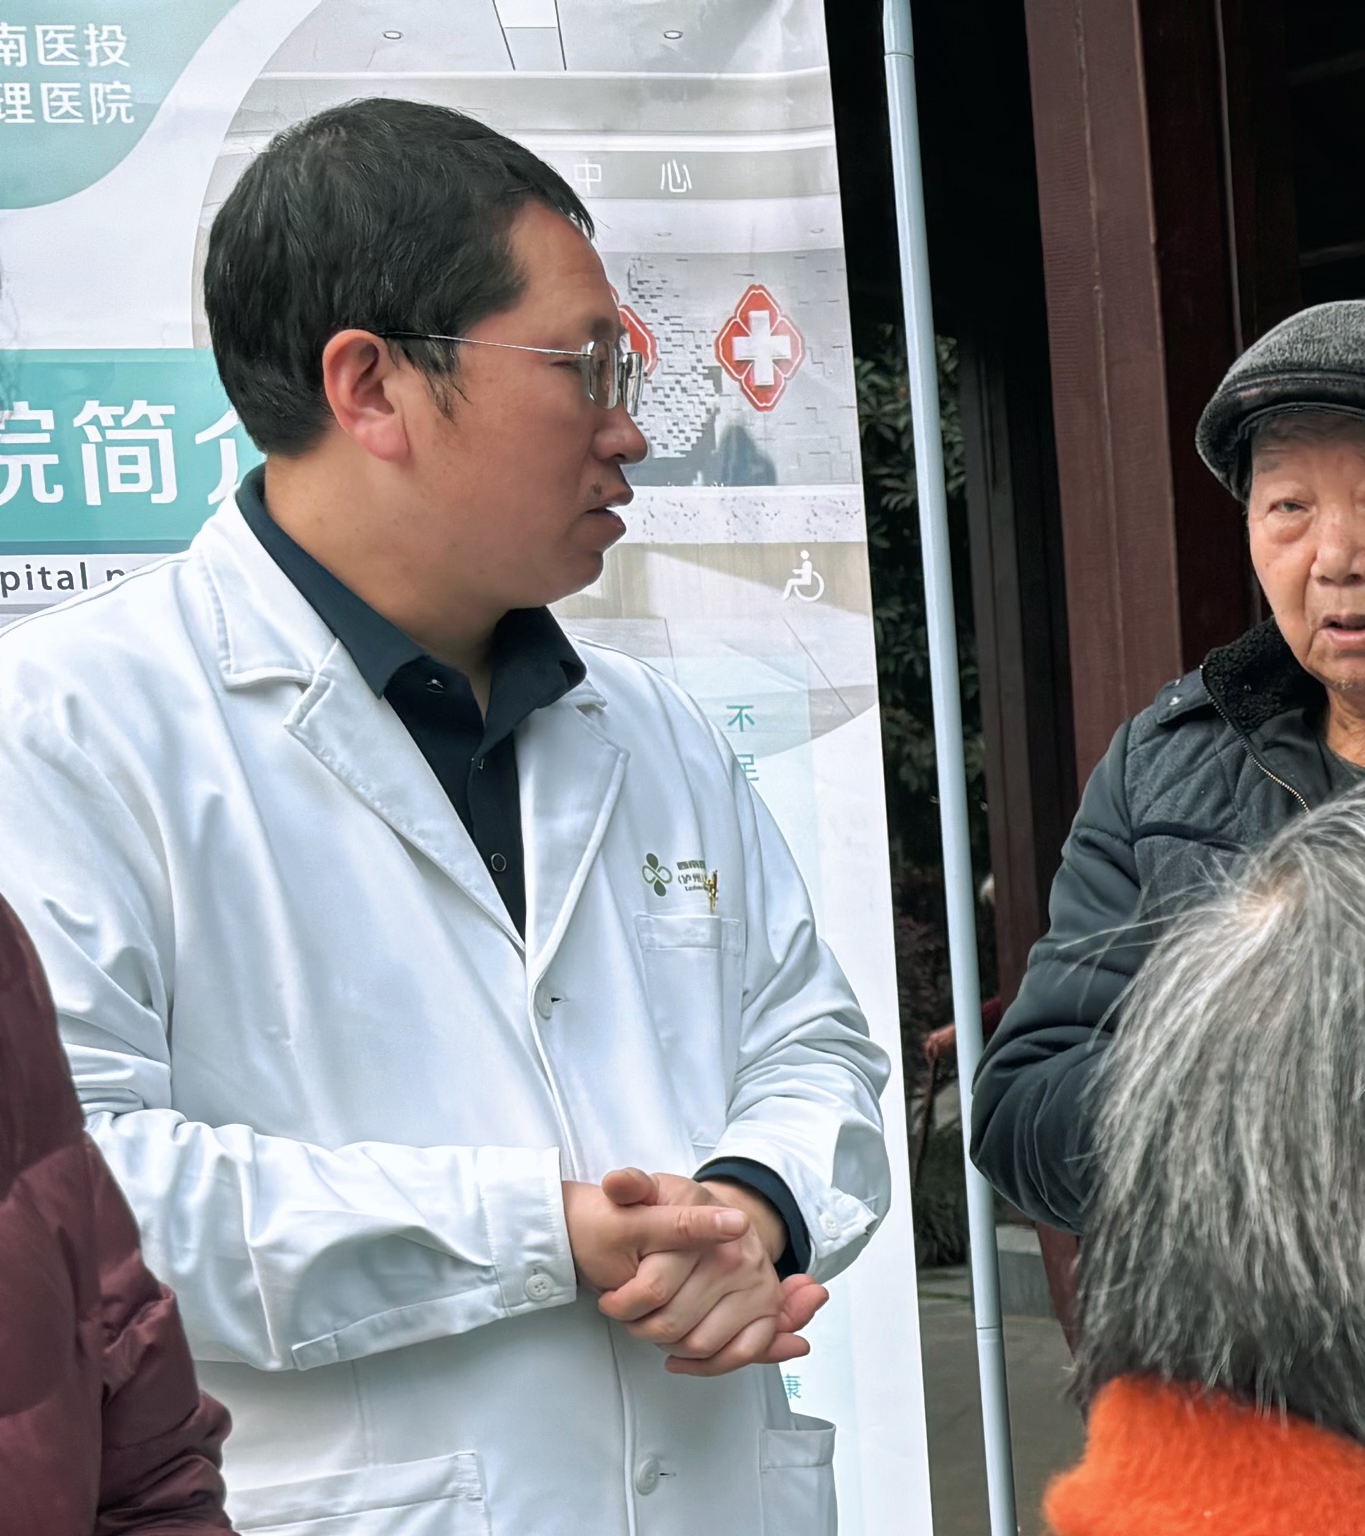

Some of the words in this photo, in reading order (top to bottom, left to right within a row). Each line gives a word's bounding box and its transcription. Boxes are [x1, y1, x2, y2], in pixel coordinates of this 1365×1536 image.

[0, 22, 131, 68] 南医投
[0, 80, 135, 125] 理医院
[573, 158, 692, 193] 中心
